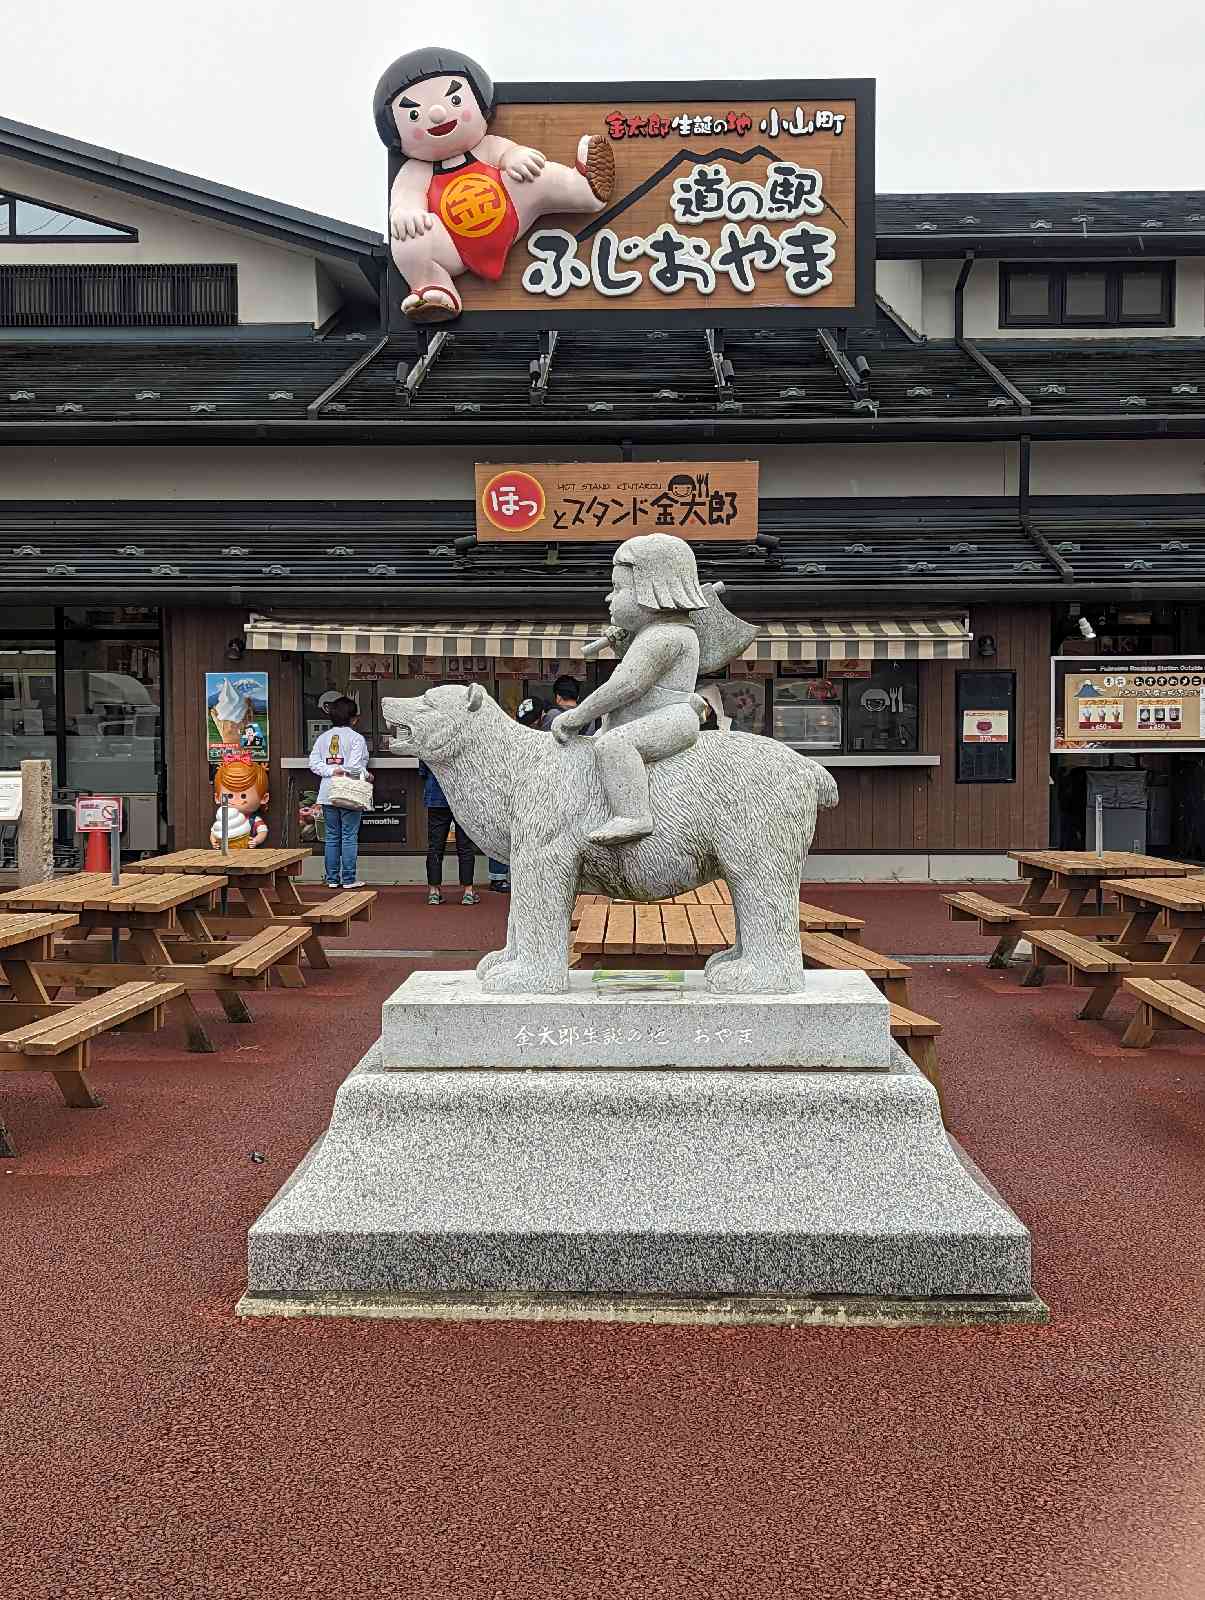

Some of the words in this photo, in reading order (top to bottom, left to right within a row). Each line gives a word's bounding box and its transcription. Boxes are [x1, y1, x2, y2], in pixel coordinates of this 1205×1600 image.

[606, 110, 753, 138] 金太郎生誕の地
[761, 106, 847, 137] 小山町
[445, 175, 503, 232] 金
[674, 164, 820, 224] 道の駅
[525, 225, 832, 293] ふじおやま
[362, 817, 400, 825] smoothie
